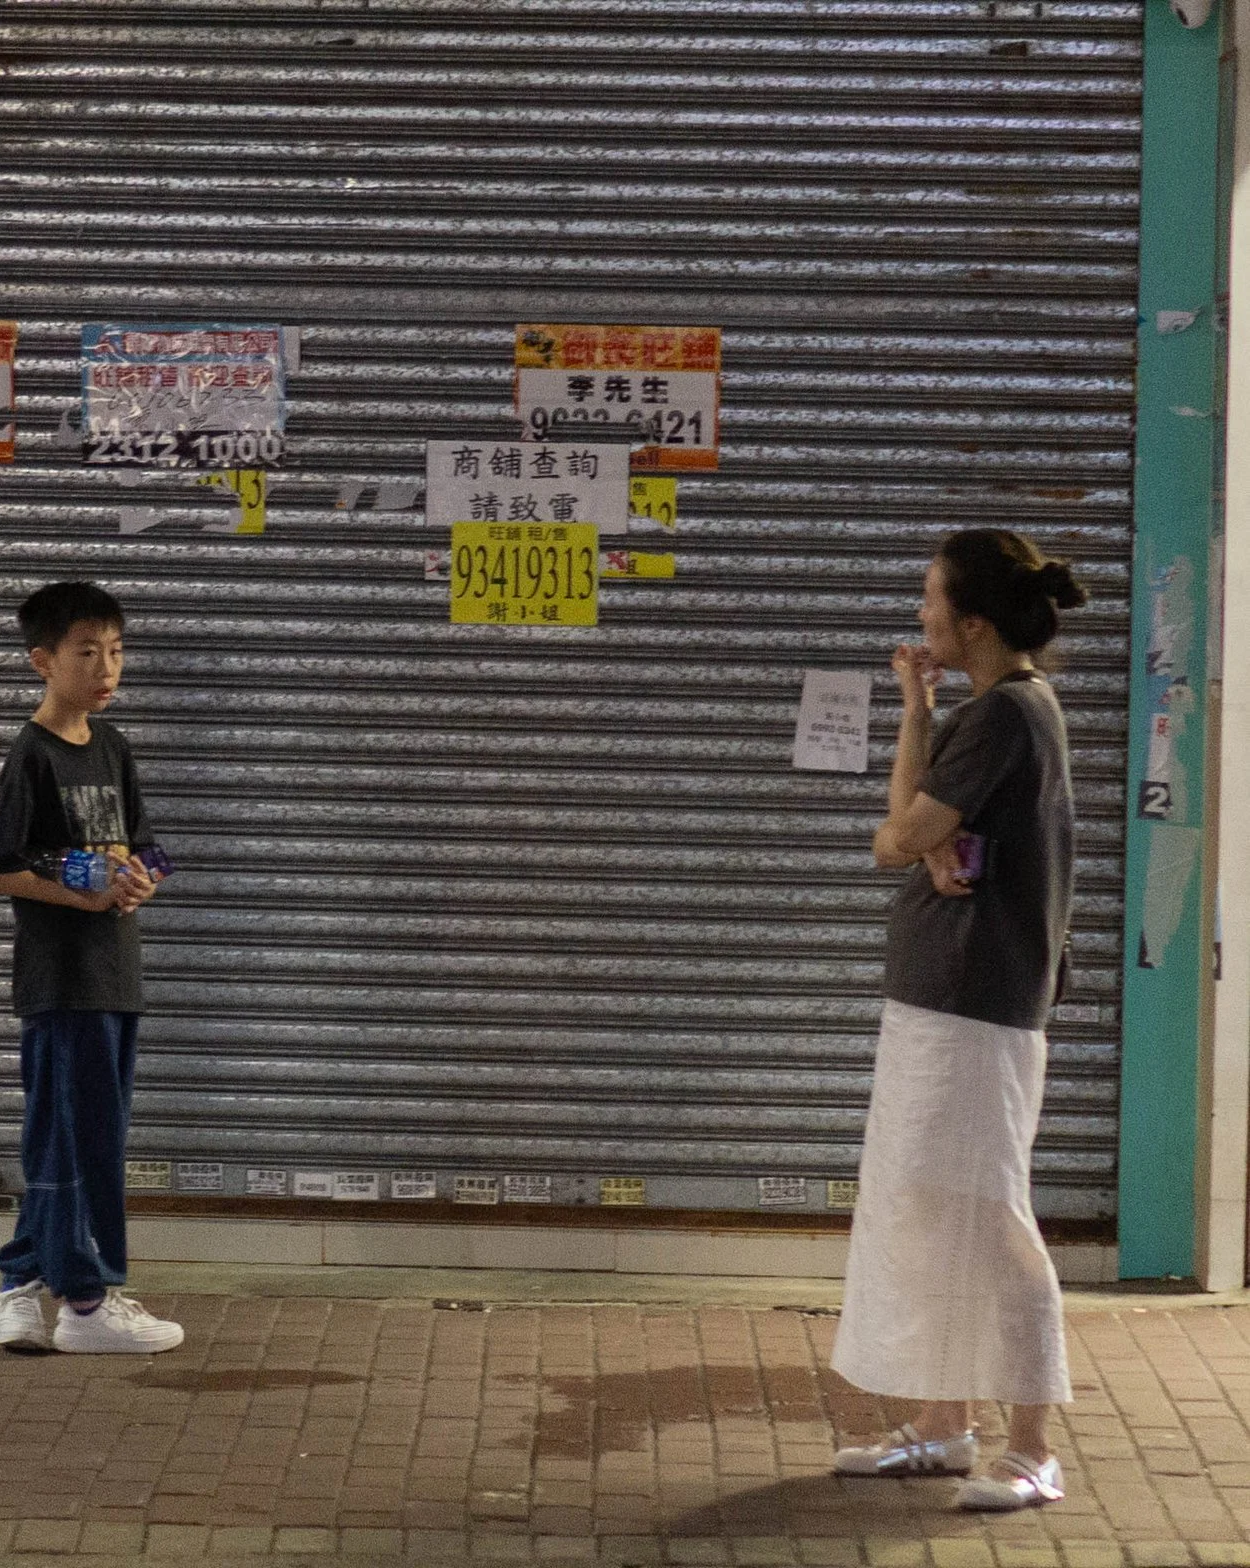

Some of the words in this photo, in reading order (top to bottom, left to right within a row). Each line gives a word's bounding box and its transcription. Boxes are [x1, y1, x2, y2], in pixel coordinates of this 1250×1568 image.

[567, 375, 669, 404] 李先生
[451, 445, 599, 480] 商舖查詢
[468, 491, 579, 523] 請致電
[456, 544, 594, 600] 93419313
[487, 602, 562, 622] 謝小姐
